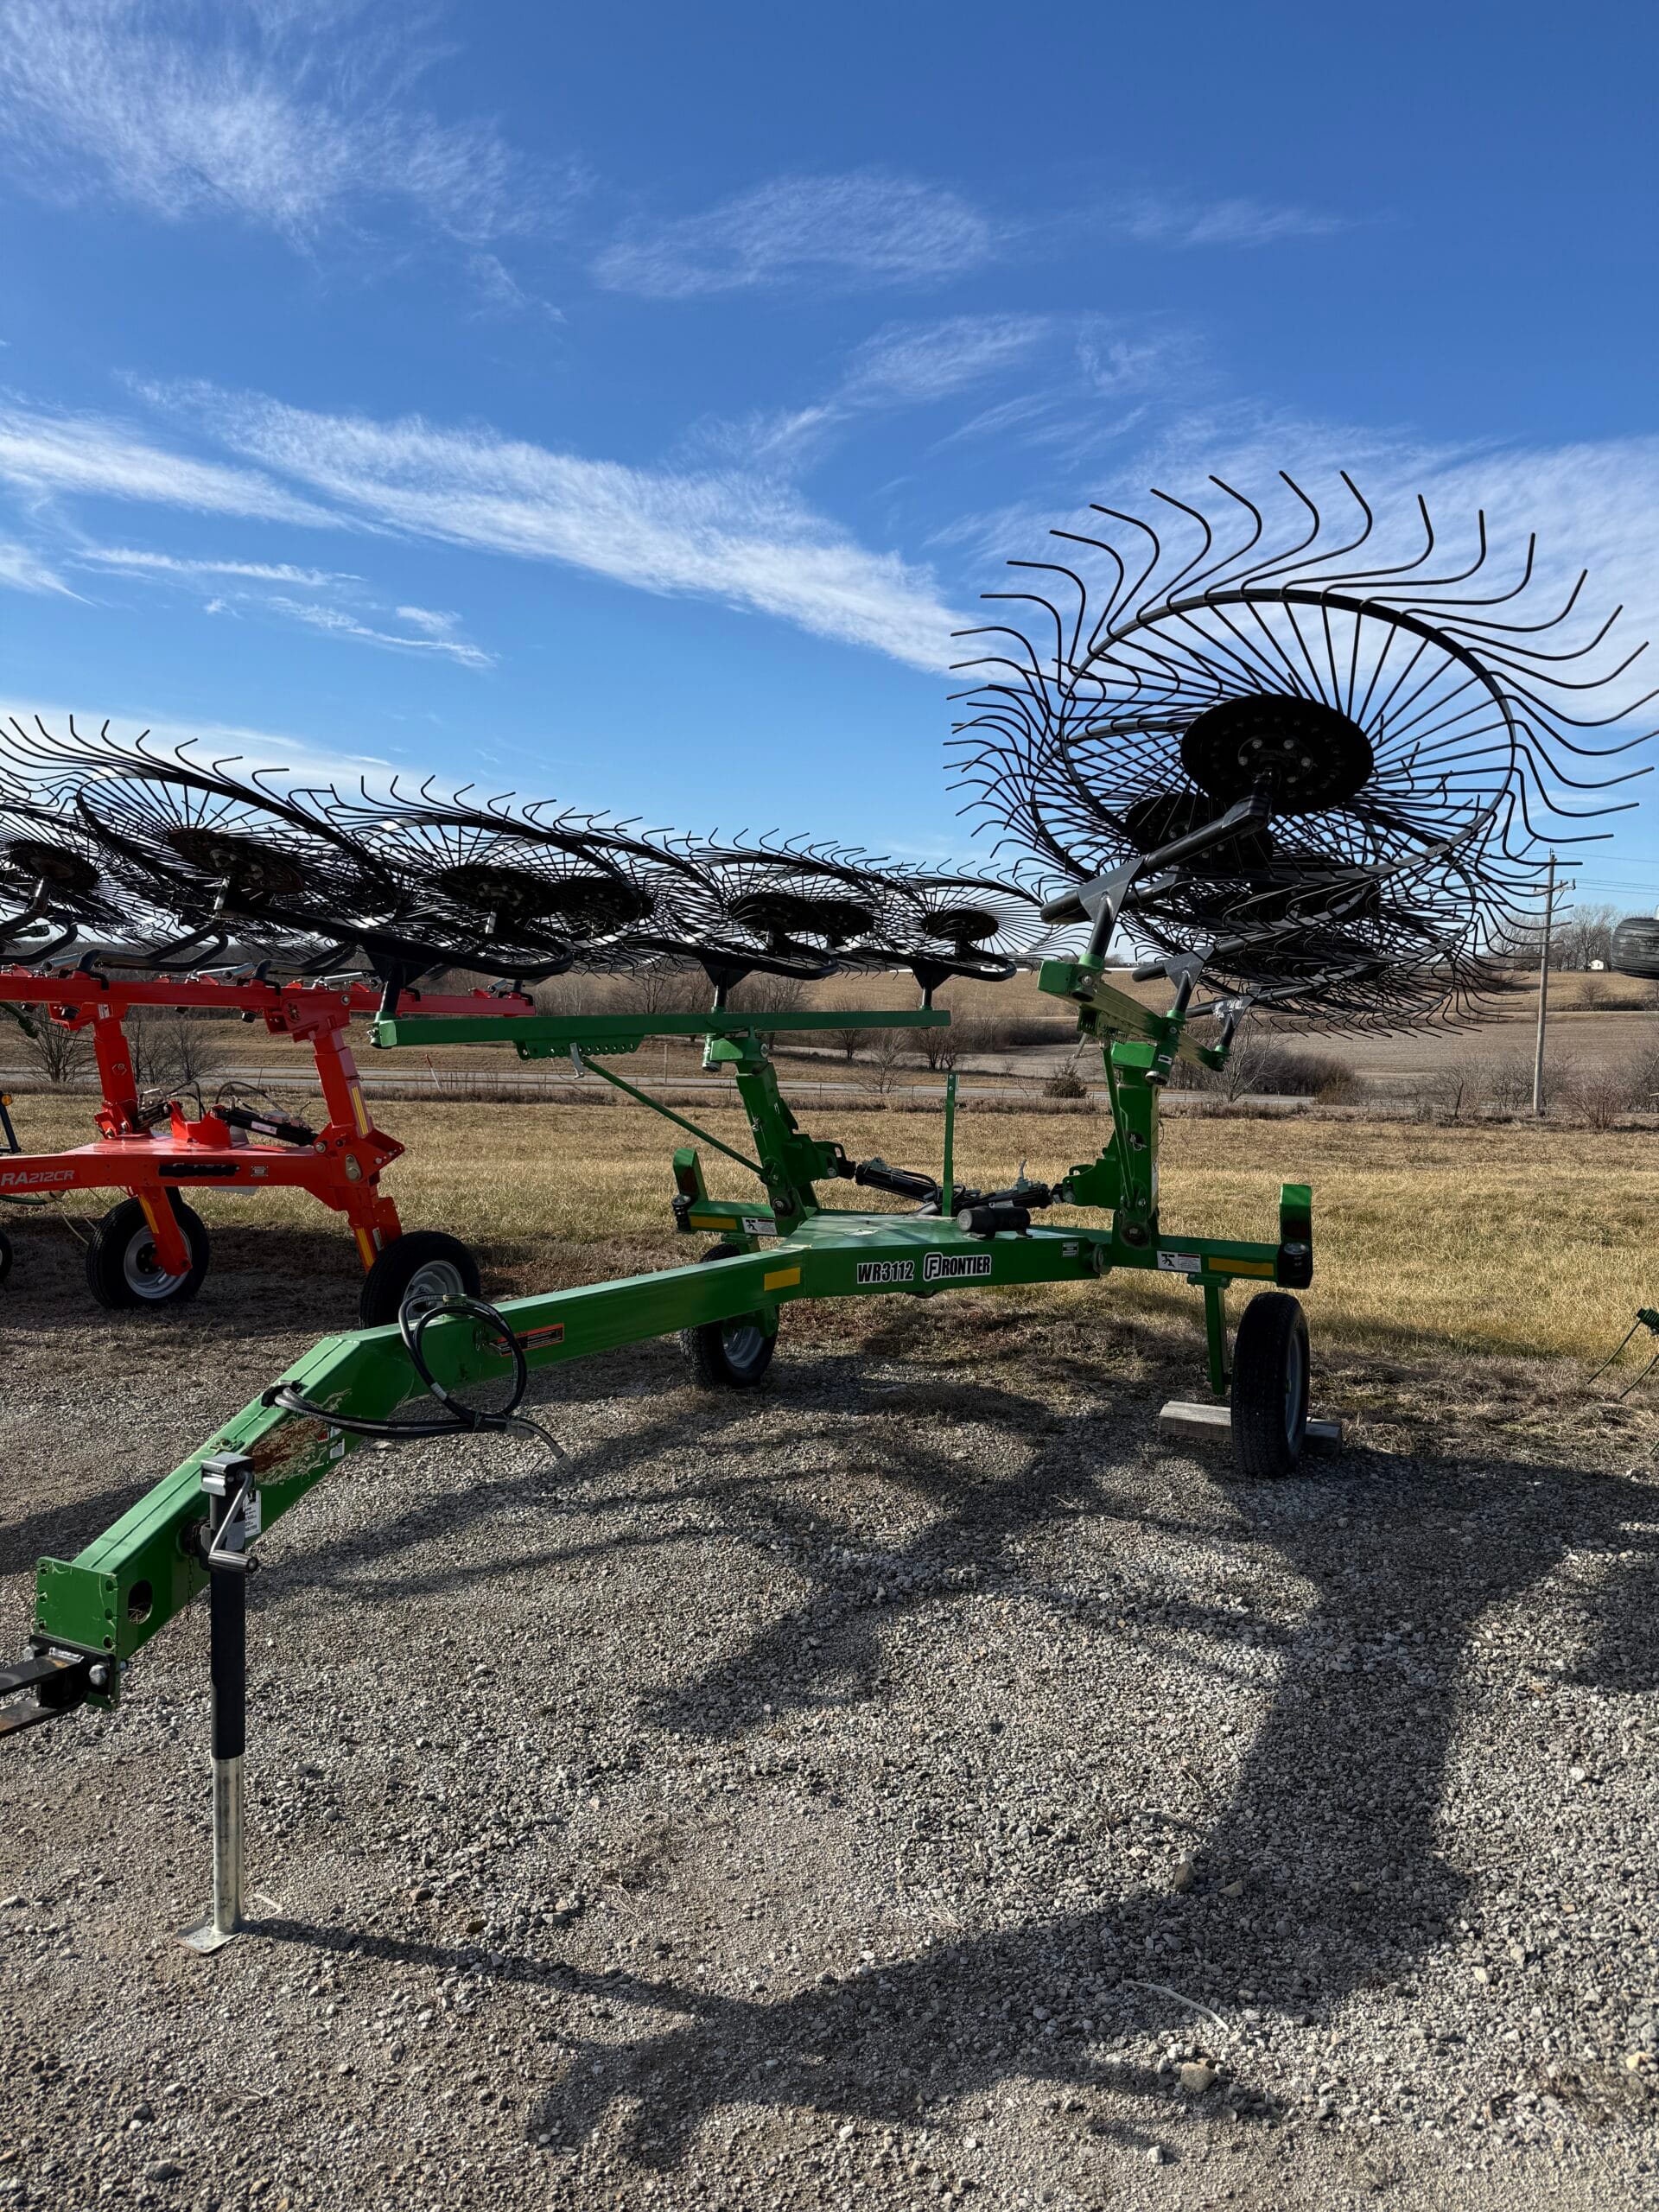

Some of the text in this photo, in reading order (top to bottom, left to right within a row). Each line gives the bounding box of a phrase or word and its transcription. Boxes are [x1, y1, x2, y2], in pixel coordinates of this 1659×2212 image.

[0, 1170, 75, 1186] RA212CR
[858, 1253, 991, 1283] WR3112 FRONTIER
